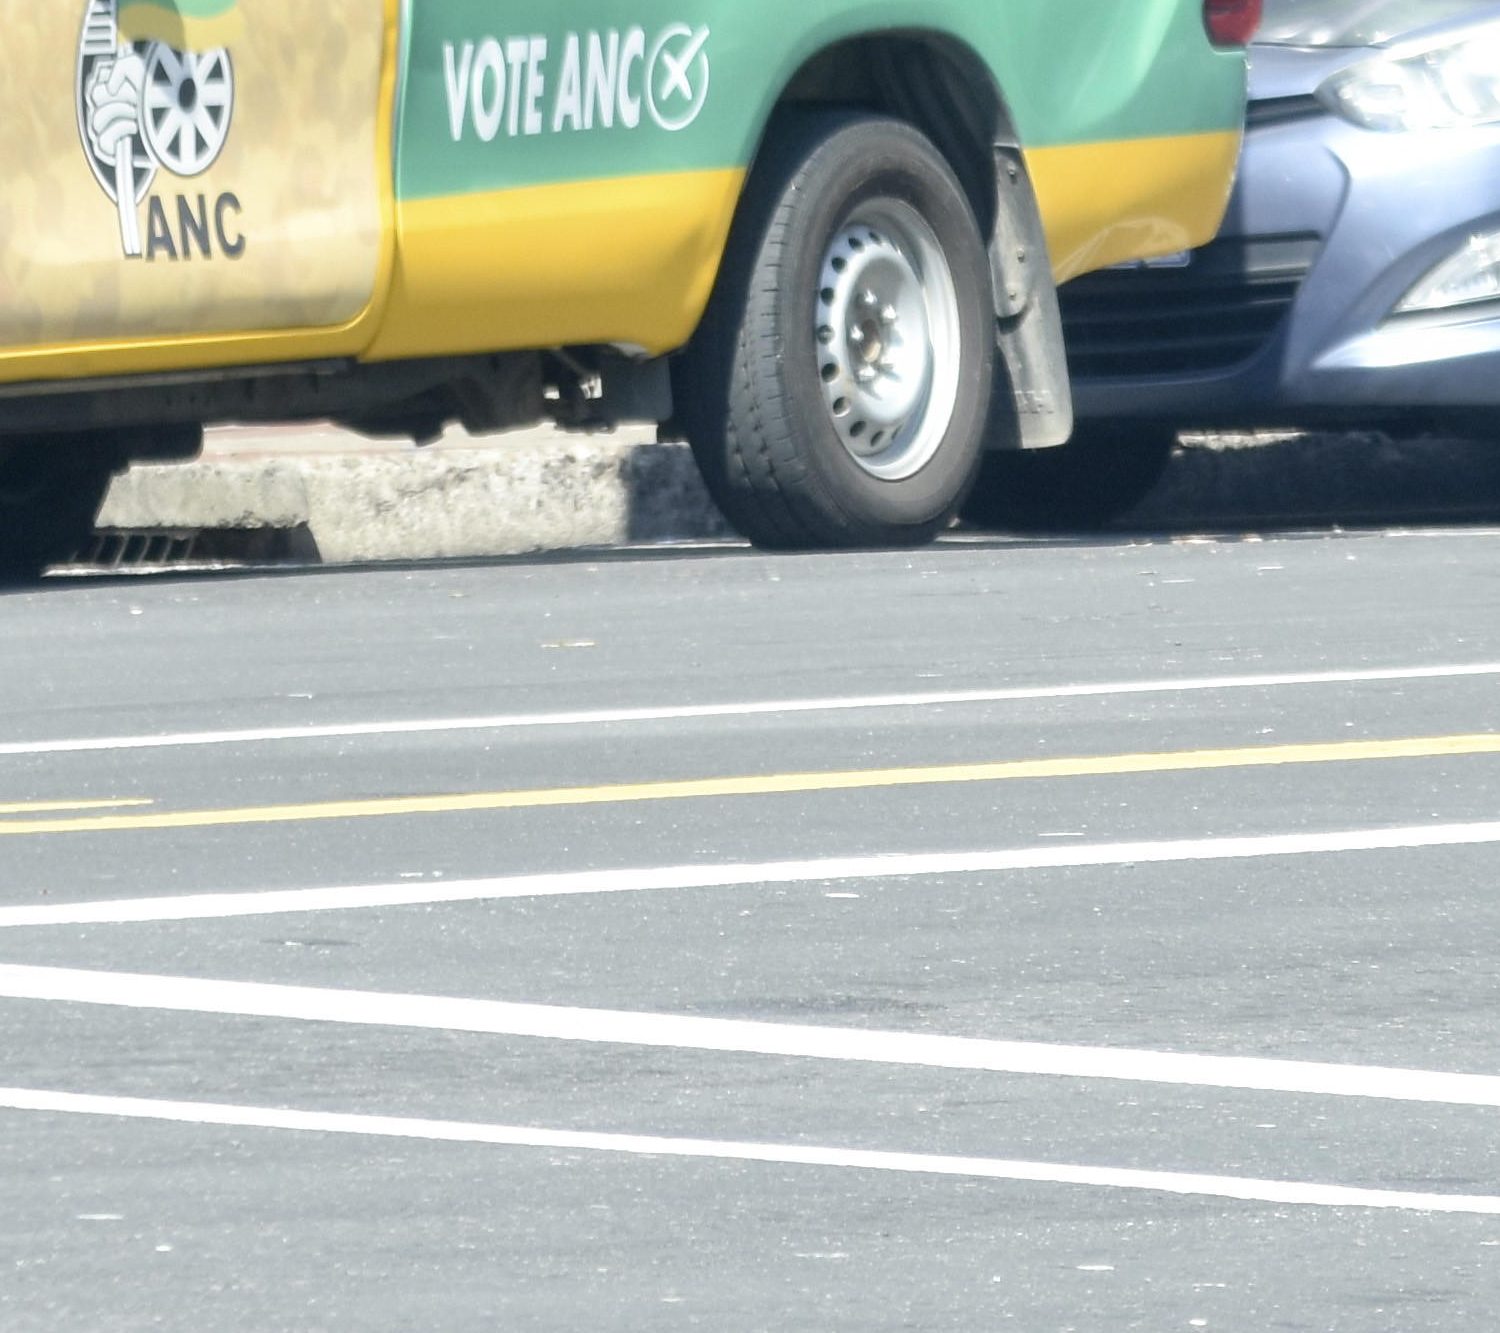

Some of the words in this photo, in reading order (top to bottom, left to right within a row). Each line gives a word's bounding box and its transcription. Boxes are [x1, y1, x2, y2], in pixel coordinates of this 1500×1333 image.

[442, 34, 546, 144] VOTE
[552, 23, 645, 135] ANC
[144, 191, 247, 263] ANC
